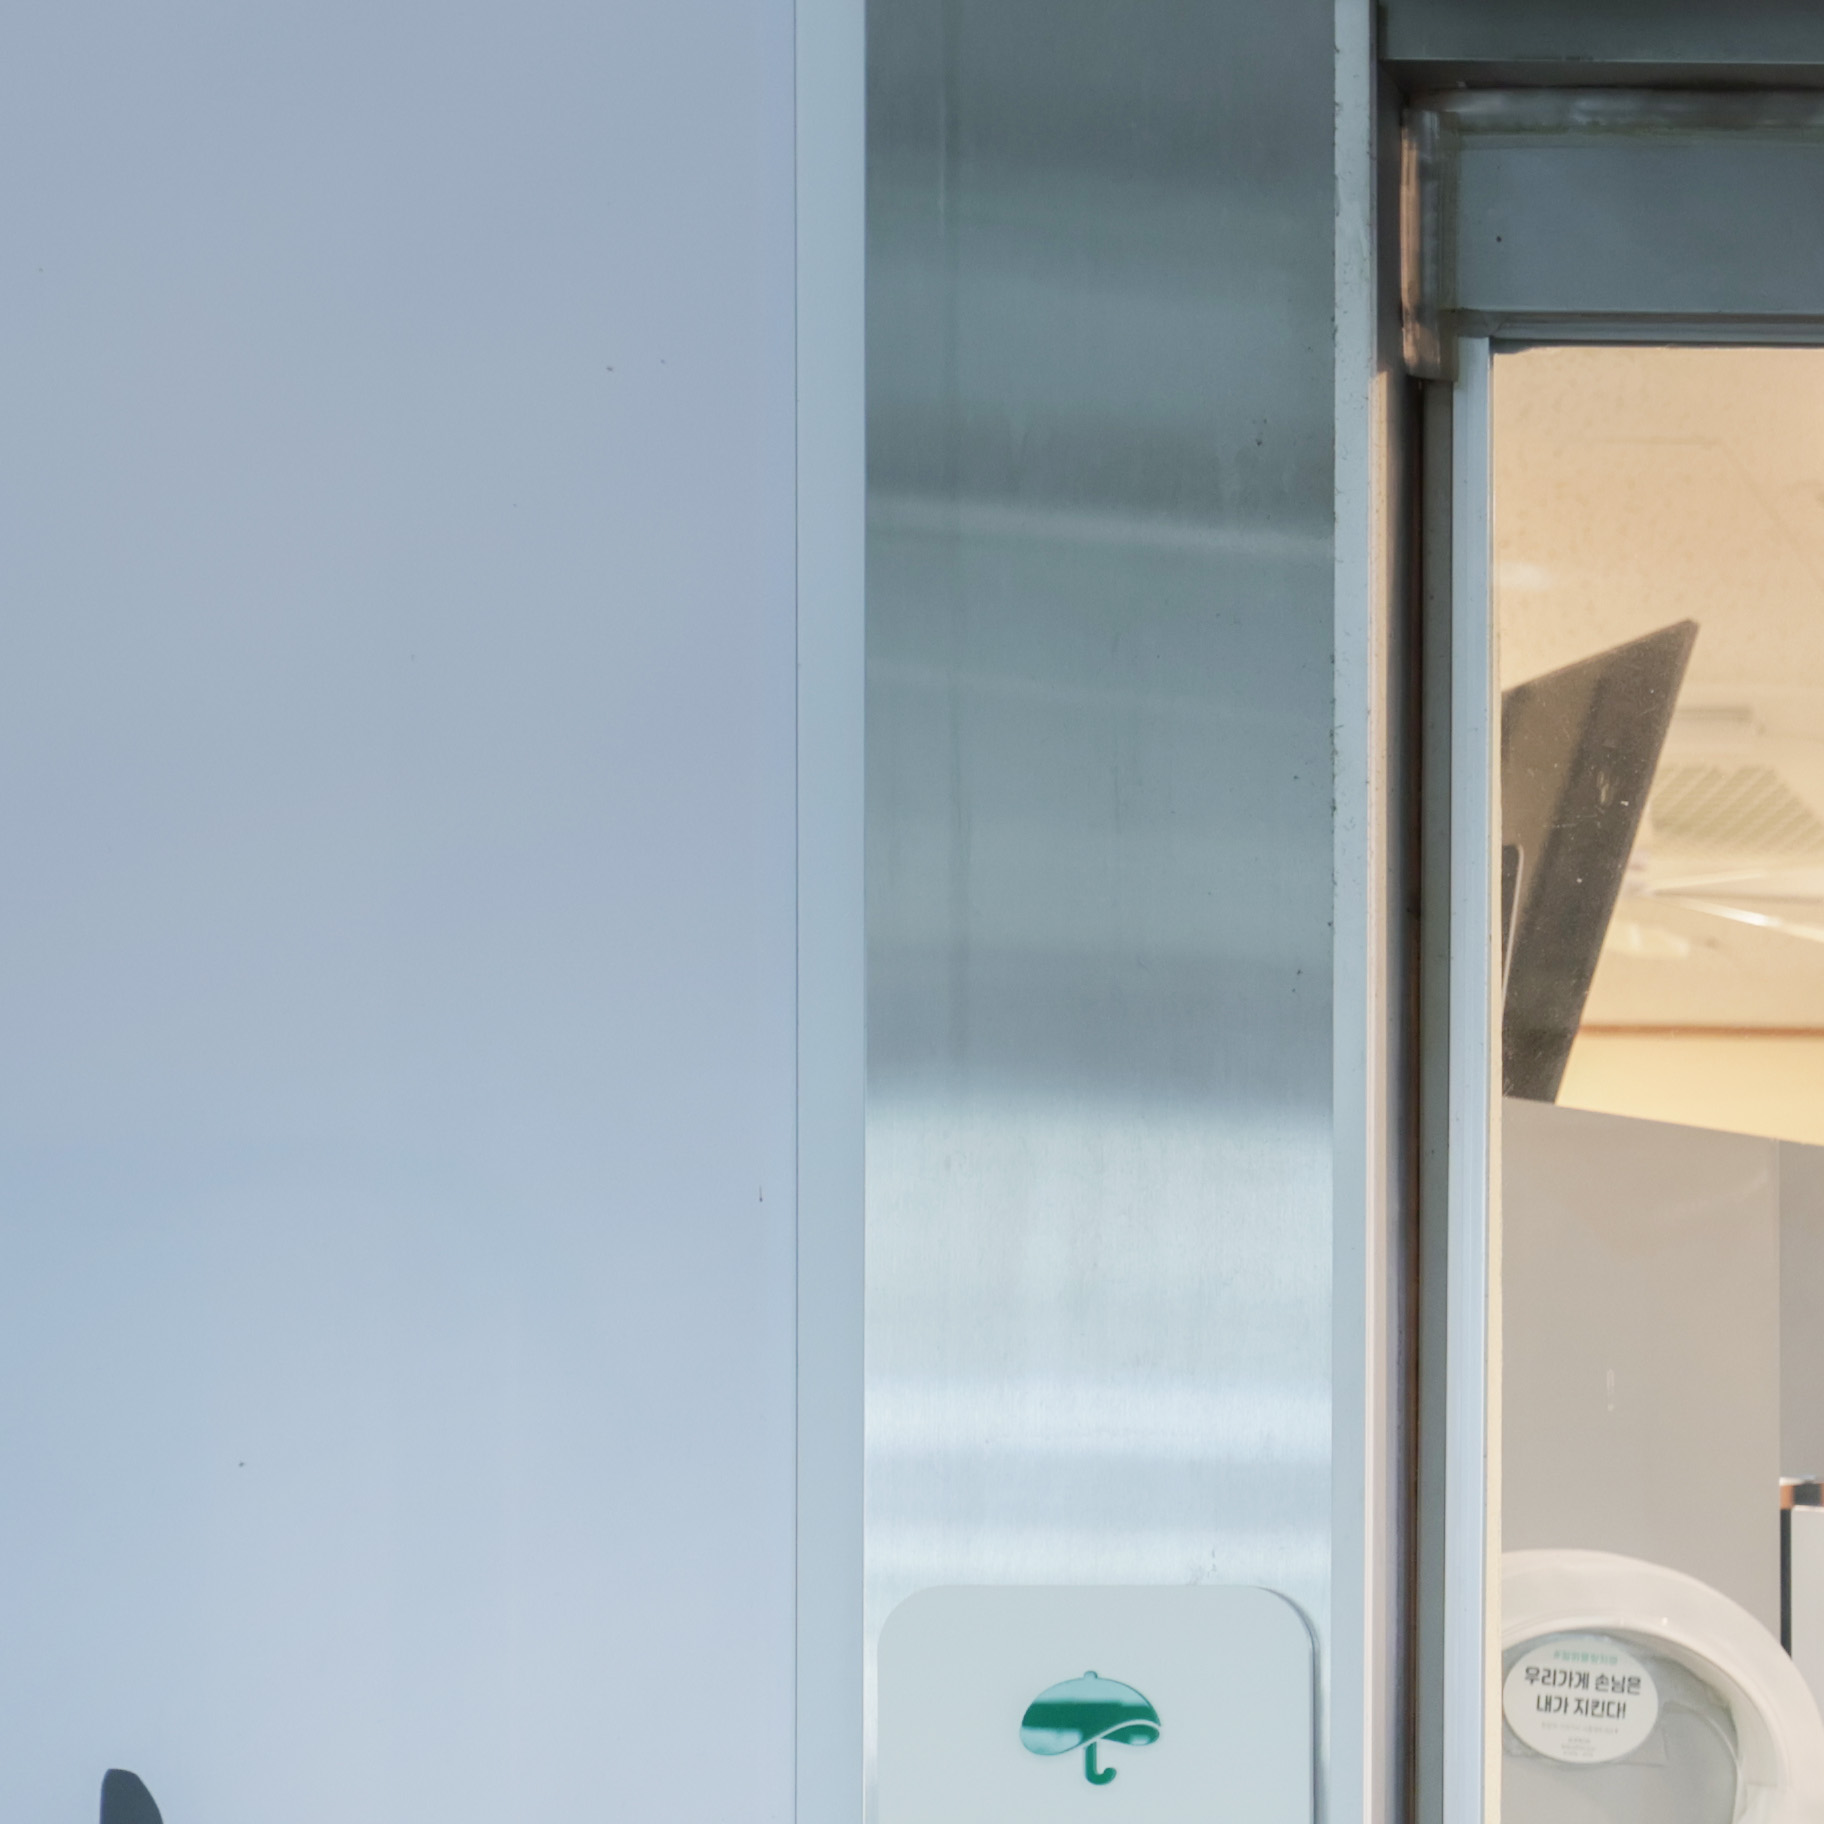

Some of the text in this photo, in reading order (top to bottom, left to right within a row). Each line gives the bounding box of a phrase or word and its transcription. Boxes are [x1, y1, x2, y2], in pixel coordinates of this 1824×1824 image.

[1524, 1666, 1642, 1695] 우리가게 손님은
[1536, 1694, 1569, 1714] 내가
